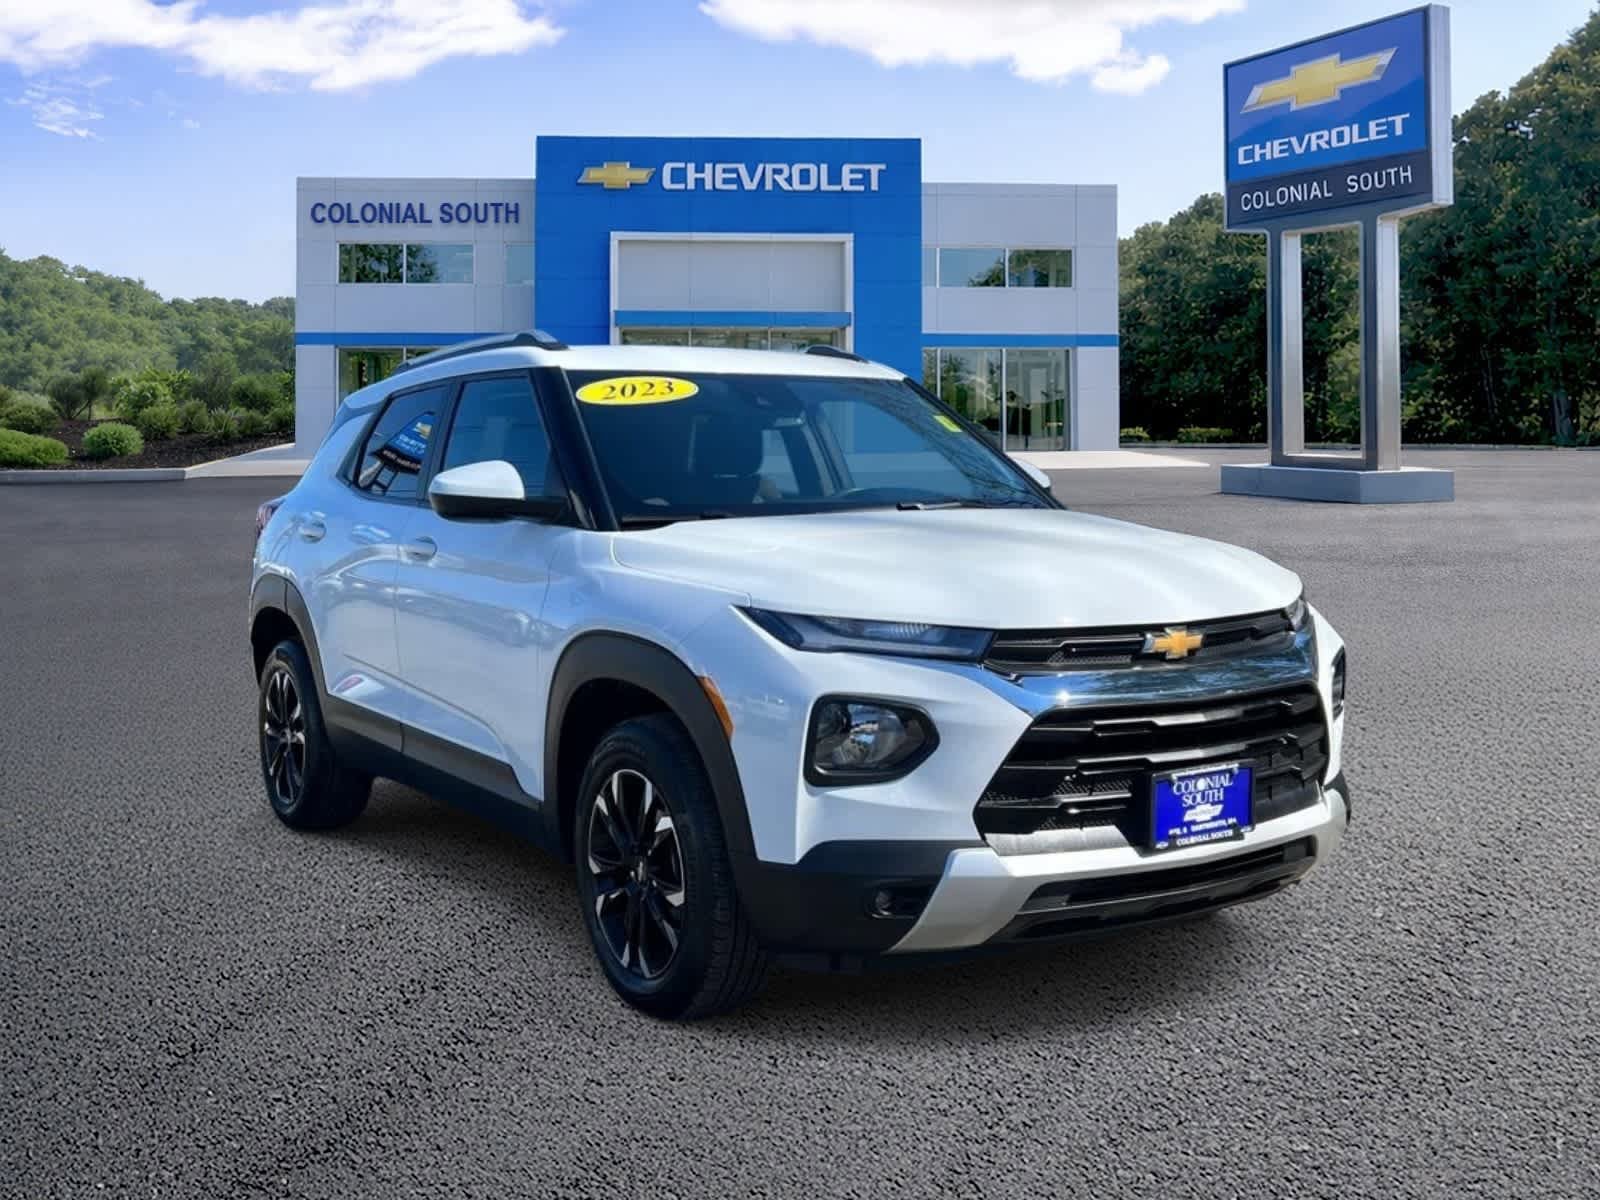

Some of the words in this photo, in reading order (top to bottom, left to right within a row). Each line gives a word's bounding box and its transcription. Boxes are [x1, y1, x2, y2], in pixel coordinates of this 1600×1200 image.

[1237, 113, 1411, 165] CHEVROLET
[662, 162, 887, 191] CHEVROLET
[1240, 179, 1333, 211] COLONIAL
[1346, 165, 1413, 193] SOUTH
[310, 202, 433, 224] COLONIAL
[439, 202, 520, 224] SOUTH
[601, 380, 674, 400] 2023
[1173, 773, 1233, 796] COLONIAL
[1182, 787, 1225, 807] SOUTH
